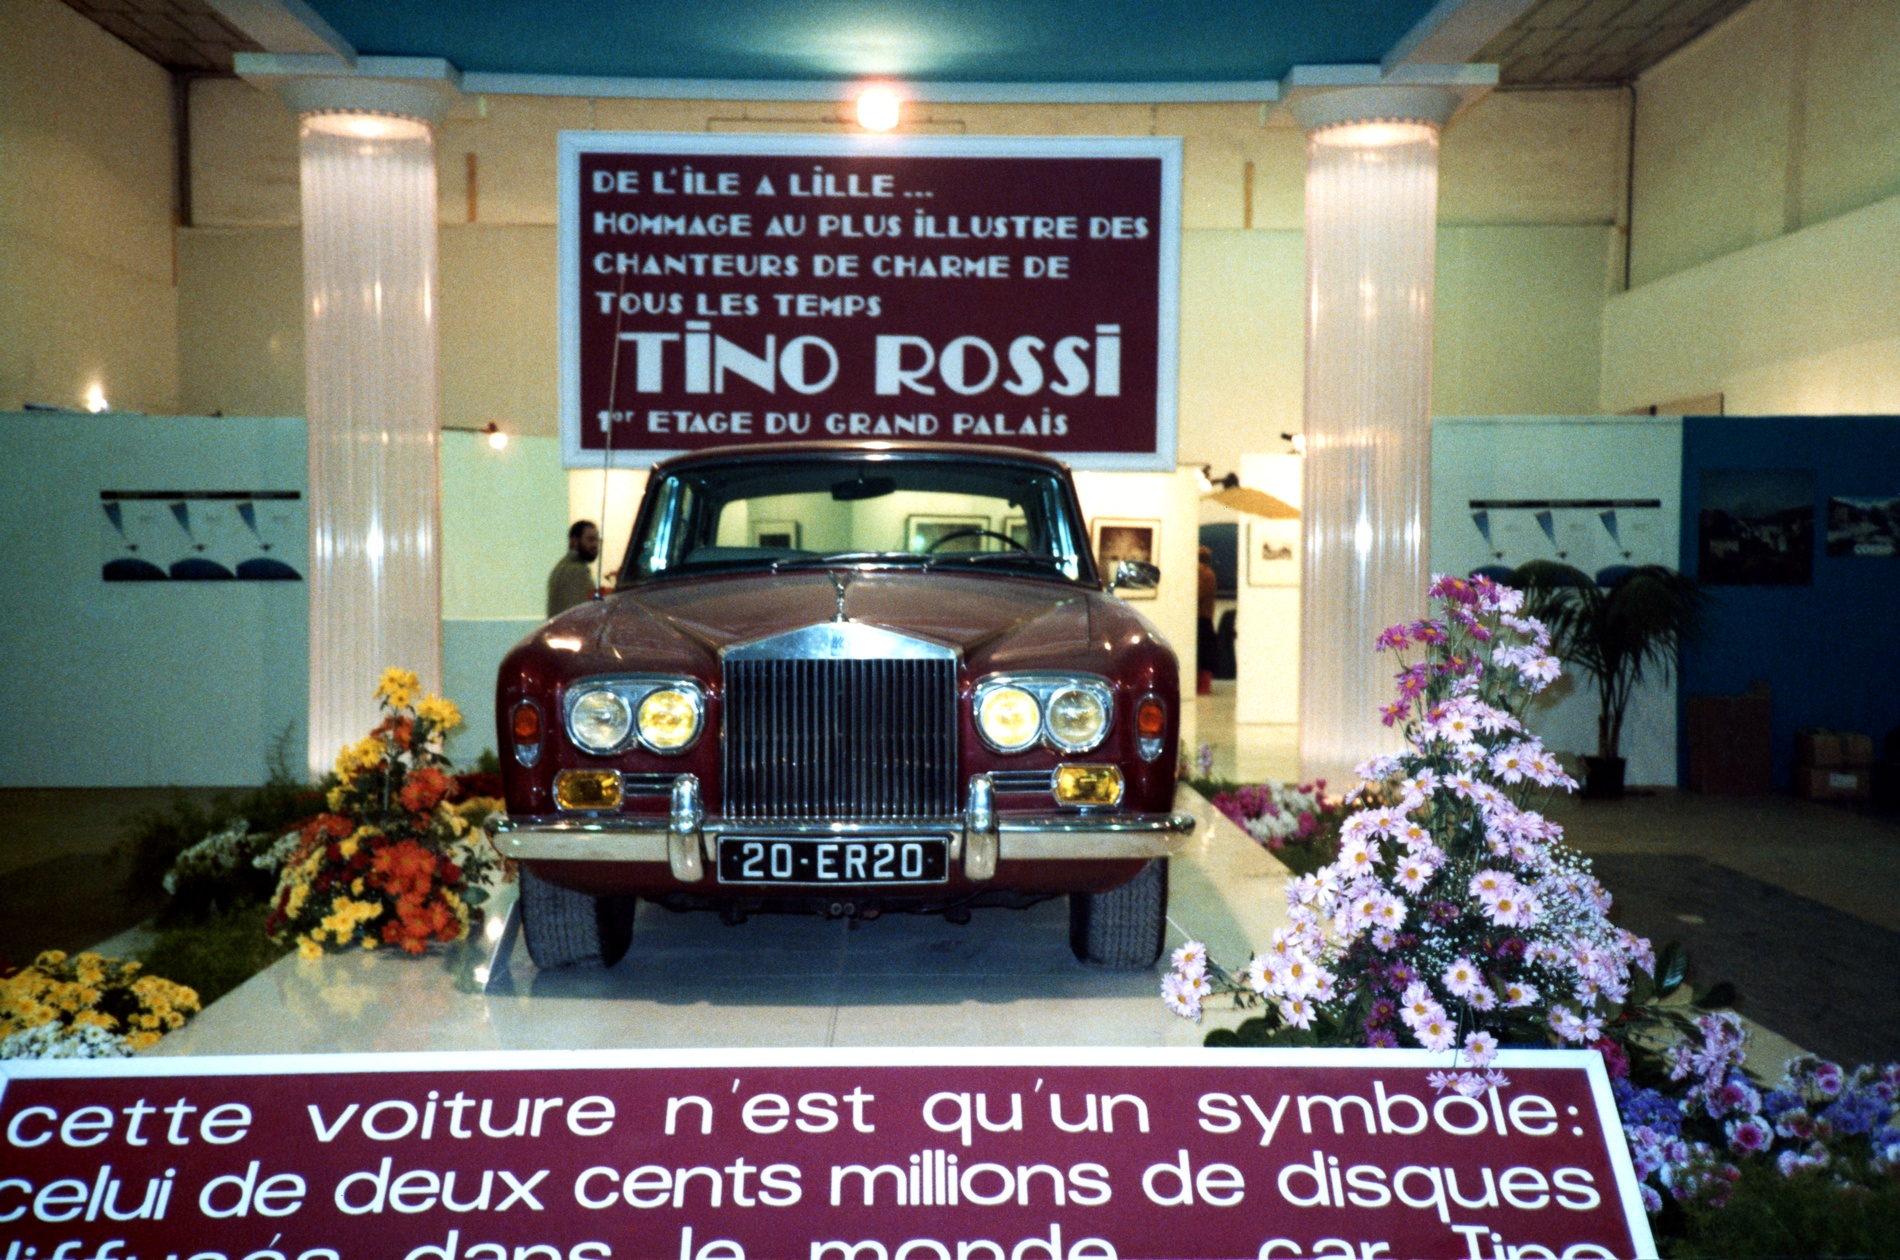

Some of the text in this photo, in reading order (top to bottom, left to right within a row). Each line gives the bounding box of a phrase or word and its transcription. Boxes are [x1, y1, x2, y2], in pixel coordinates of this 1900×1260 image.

[592, 170, 638, 194] DE
[755, 175, 775, 195] A
[594, 211, 751, 237] HOMMAGE
[765, 214, 806, 237] AU
[818, 214, 902, 238] PLUS
[1089, 216, 1149, 239] DES
[593, 252, 1069, 279] CHANTEURS DE CHARME DE
[595, 291, 882, 317] TOUS LES TEMPS
[647, 410, 752, 434] ETAGE
[765, 412, 811, 435] DU
[825, 412, 939, 436] GRAND
[742, 842, 923, 879] 20-ER20
[7, 1078, 1584, 1148] cette voiture n'est qu'un symbole:
[0, 1148, 1601, 1224] celui de deux cents millions de disques
